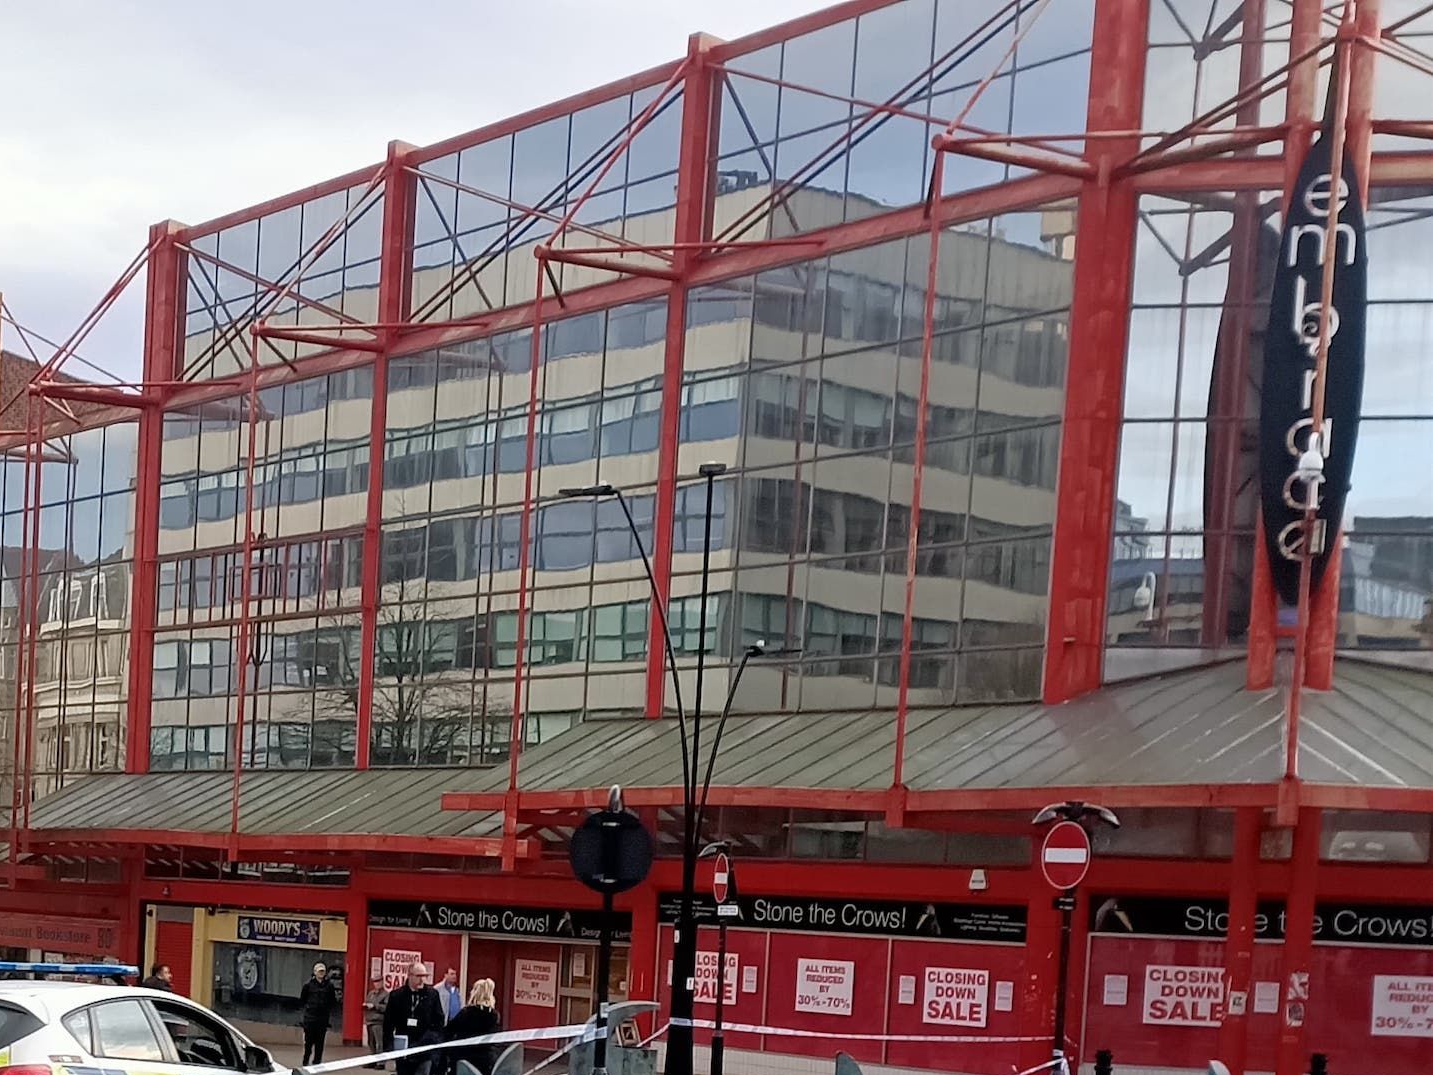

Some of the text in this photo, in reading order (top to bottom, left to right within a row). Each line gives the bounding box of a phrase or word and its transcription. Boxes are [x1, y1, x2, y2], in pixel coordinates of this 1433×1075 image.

[438, 906, 549, 932] Stone the Crows!
[754, 899, 803, 923] Stone
[809, 902, 835, 925] the
[842, 903, 906, 928] Crows!
[1185, 905, 1269, 932] Stoe
[1277, 910, 1323, 934] te
[253, 919, 301, 936] WOODY'S
[805, 965, 846, 975] ALL ITEMS
[1149, 969, 1223, 983] CLOSIN
[806, 974, 844, 984] REDUCED
[927, 971, 986, 986] CLOSING
[819, 984, 830, 993] BY
[936, 986, 976, 1000] DOWN
[1161, 985, 1220, 999] DOWN
[927, 1000, 982, 1021] SALE
[1149, 1000, 1224, 1021] SALE
[1412, 1005, 1429, 1014] BY
